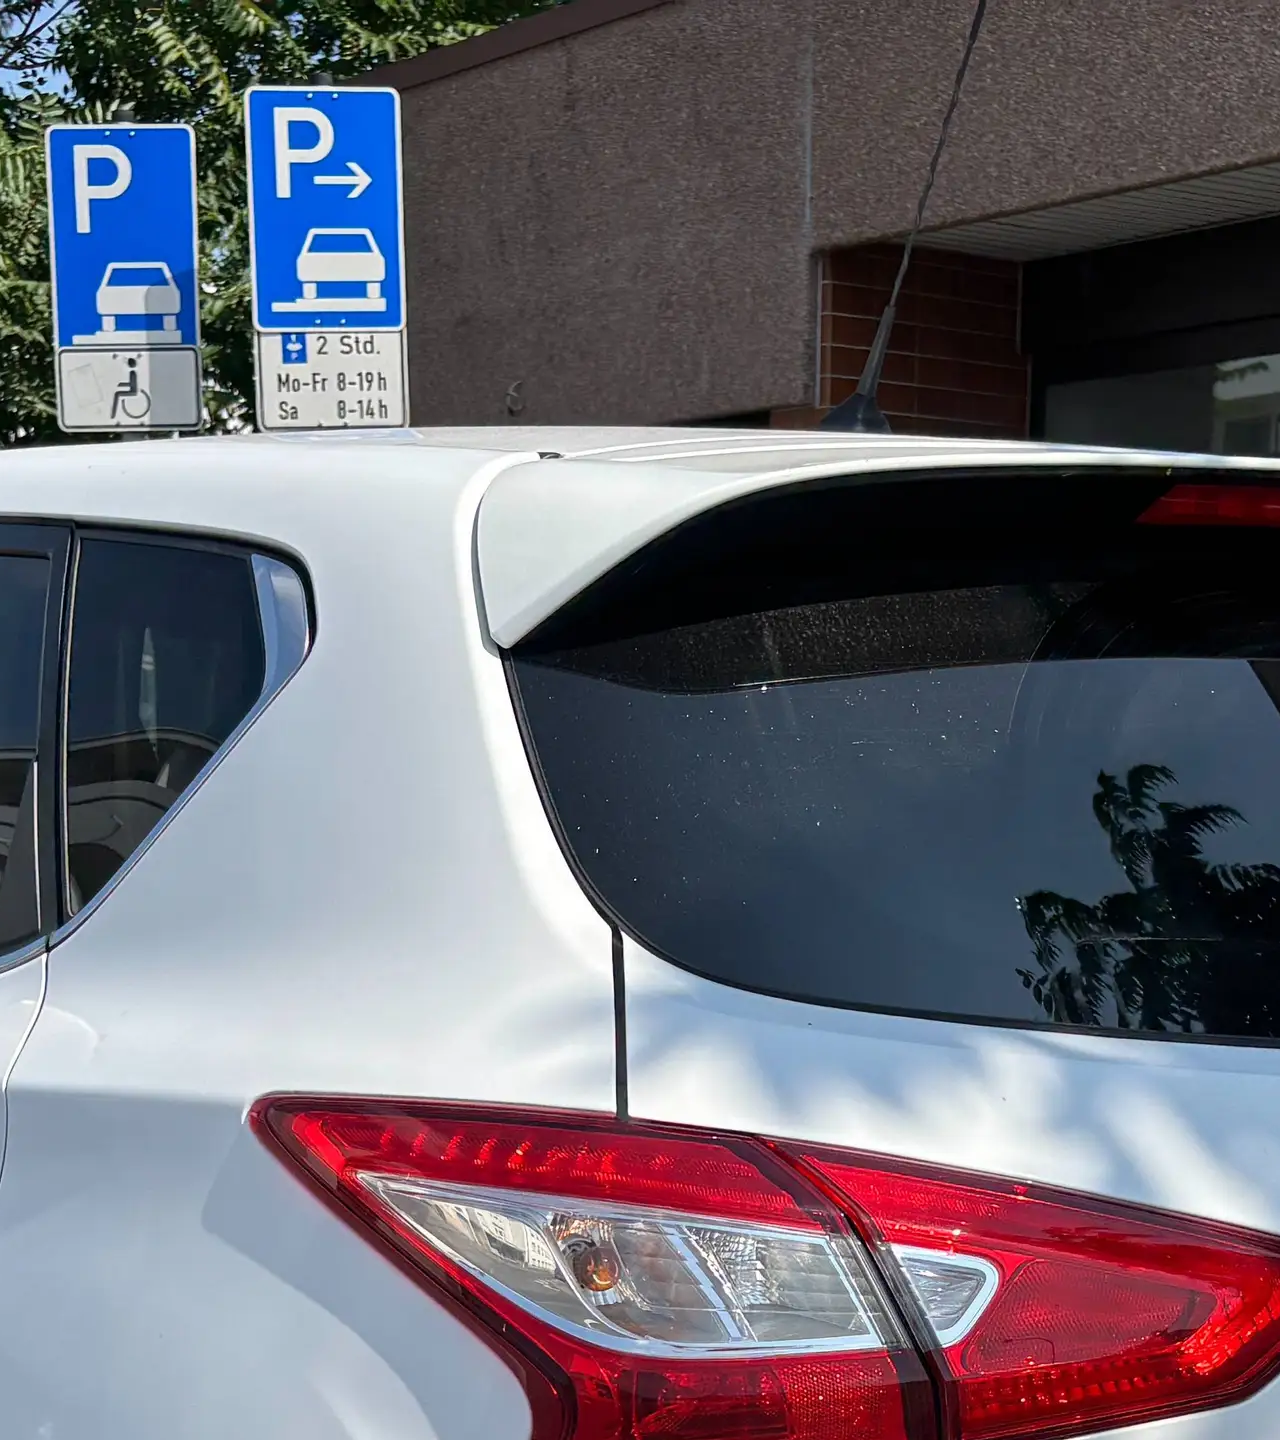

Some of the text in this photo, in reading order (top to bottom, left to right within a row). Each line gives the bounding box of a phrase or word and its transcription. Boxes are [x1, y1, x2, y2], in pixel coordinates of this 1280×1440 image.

[273, 106, 334, 199] P
[73, 144, 132, 234] P
[316, 334, 381, 355] 2 Std.
[277, 373, 328, 393] Mo-Fr
[278, 401, 299, 421] Sa
